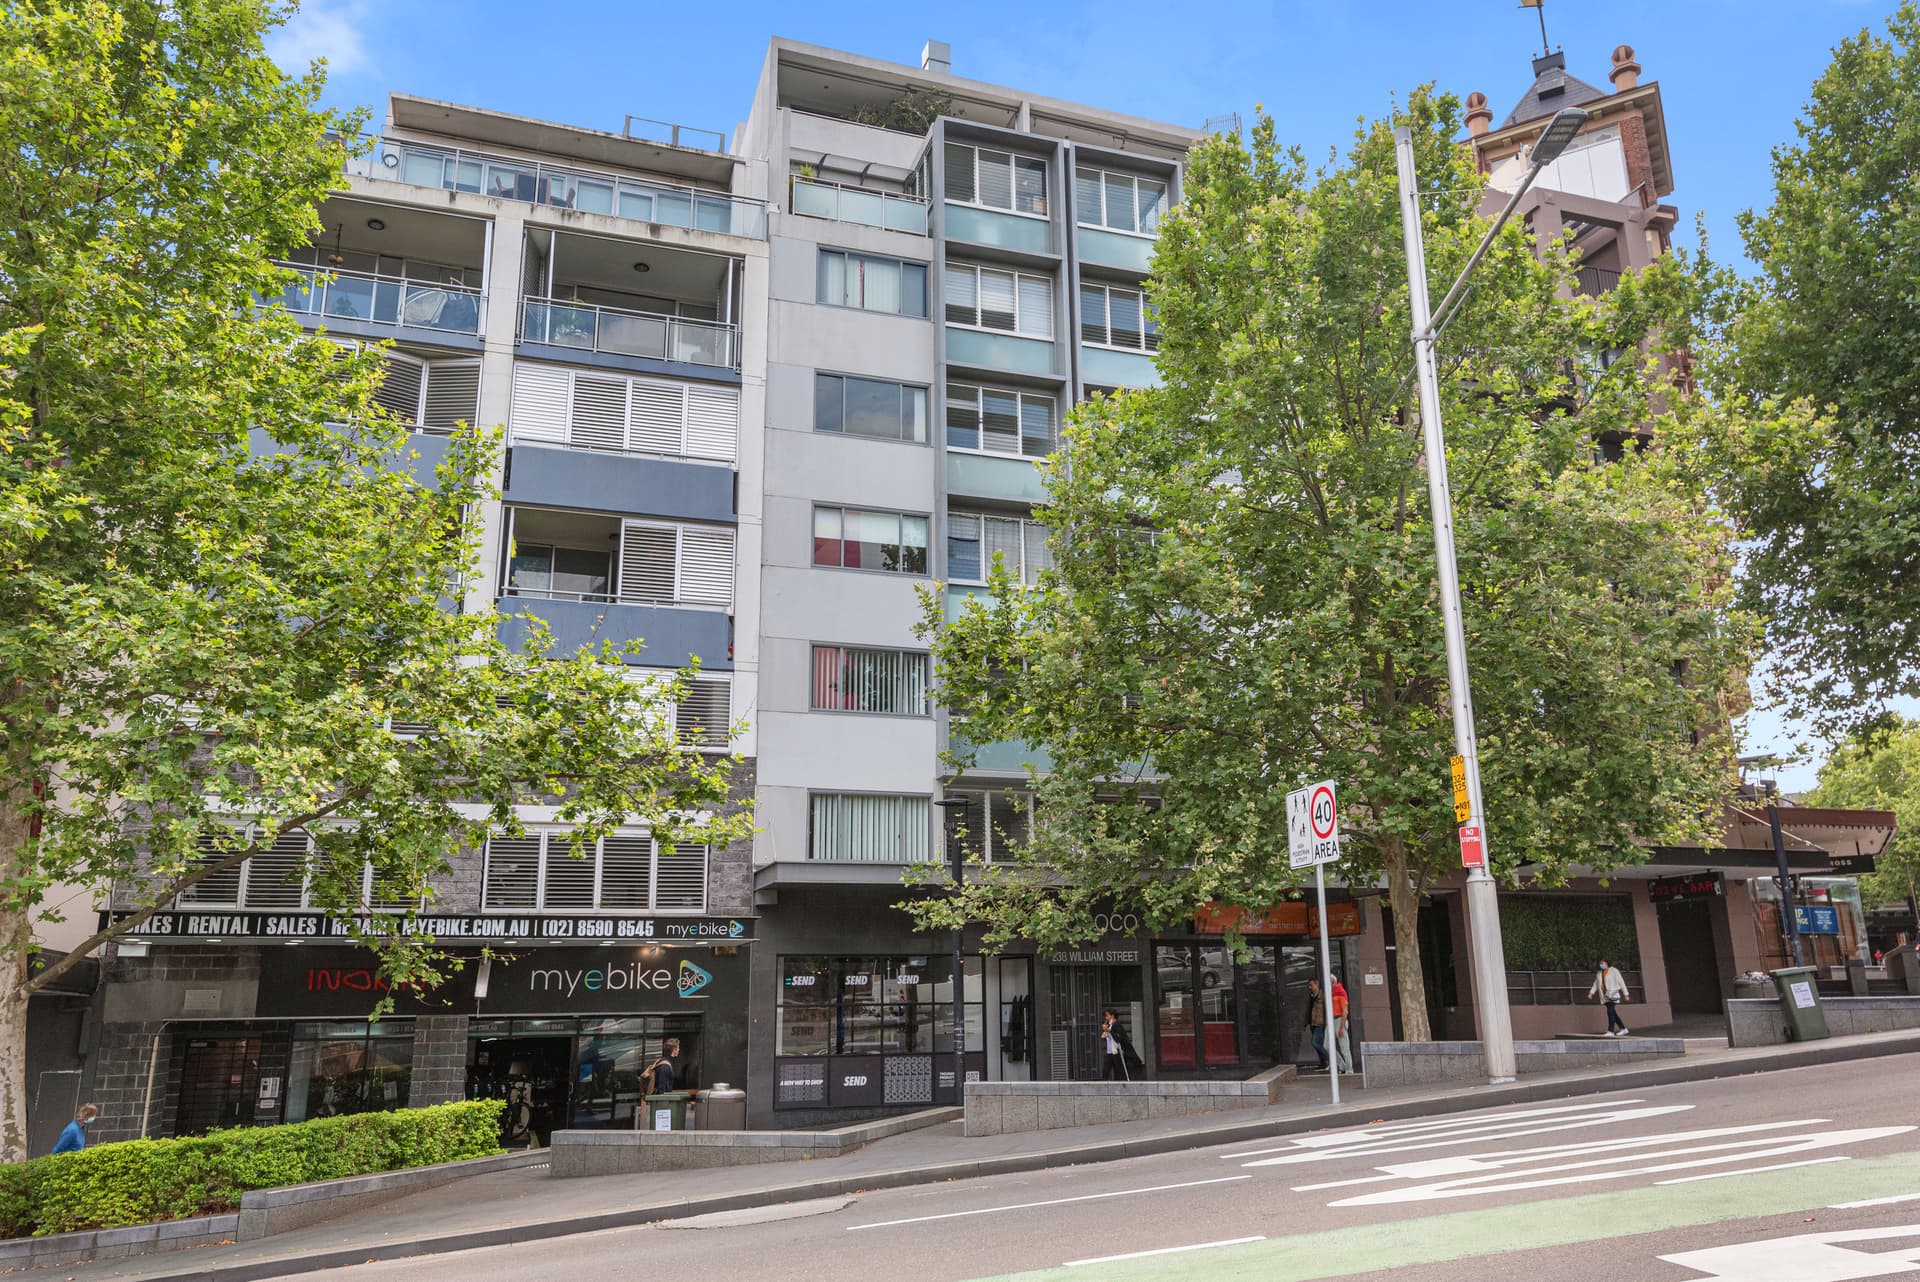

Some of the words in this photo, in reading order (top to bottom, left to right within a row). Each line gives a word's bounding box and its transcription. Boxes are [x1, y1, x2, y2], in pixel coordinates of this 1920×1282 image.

[1315, 800, 1331, 824] 40
[1315, 840, 1338, 860] AREA
[187, 915, 250, 934] RENTAL
[266, 917, 317, 935] SALES
[402, 918, 530, 936] MYEBIKE.COM.AU
[542, 919, 574, 937] (02)
[617, 919, 654, 937] 8545
[666, 922, 729, 937] myebike
[1069, 951, 1104, 962] WILLIAM
[1106, 950, 1138, 962] STREET
[530, 962, 671, 998] myebike
[791, 975, 815, 986] SEND
[845, 975, 868, 985] SEND
[896, 974, 919, 985] SEND
[843, 1075, 867, 1087] SEND
